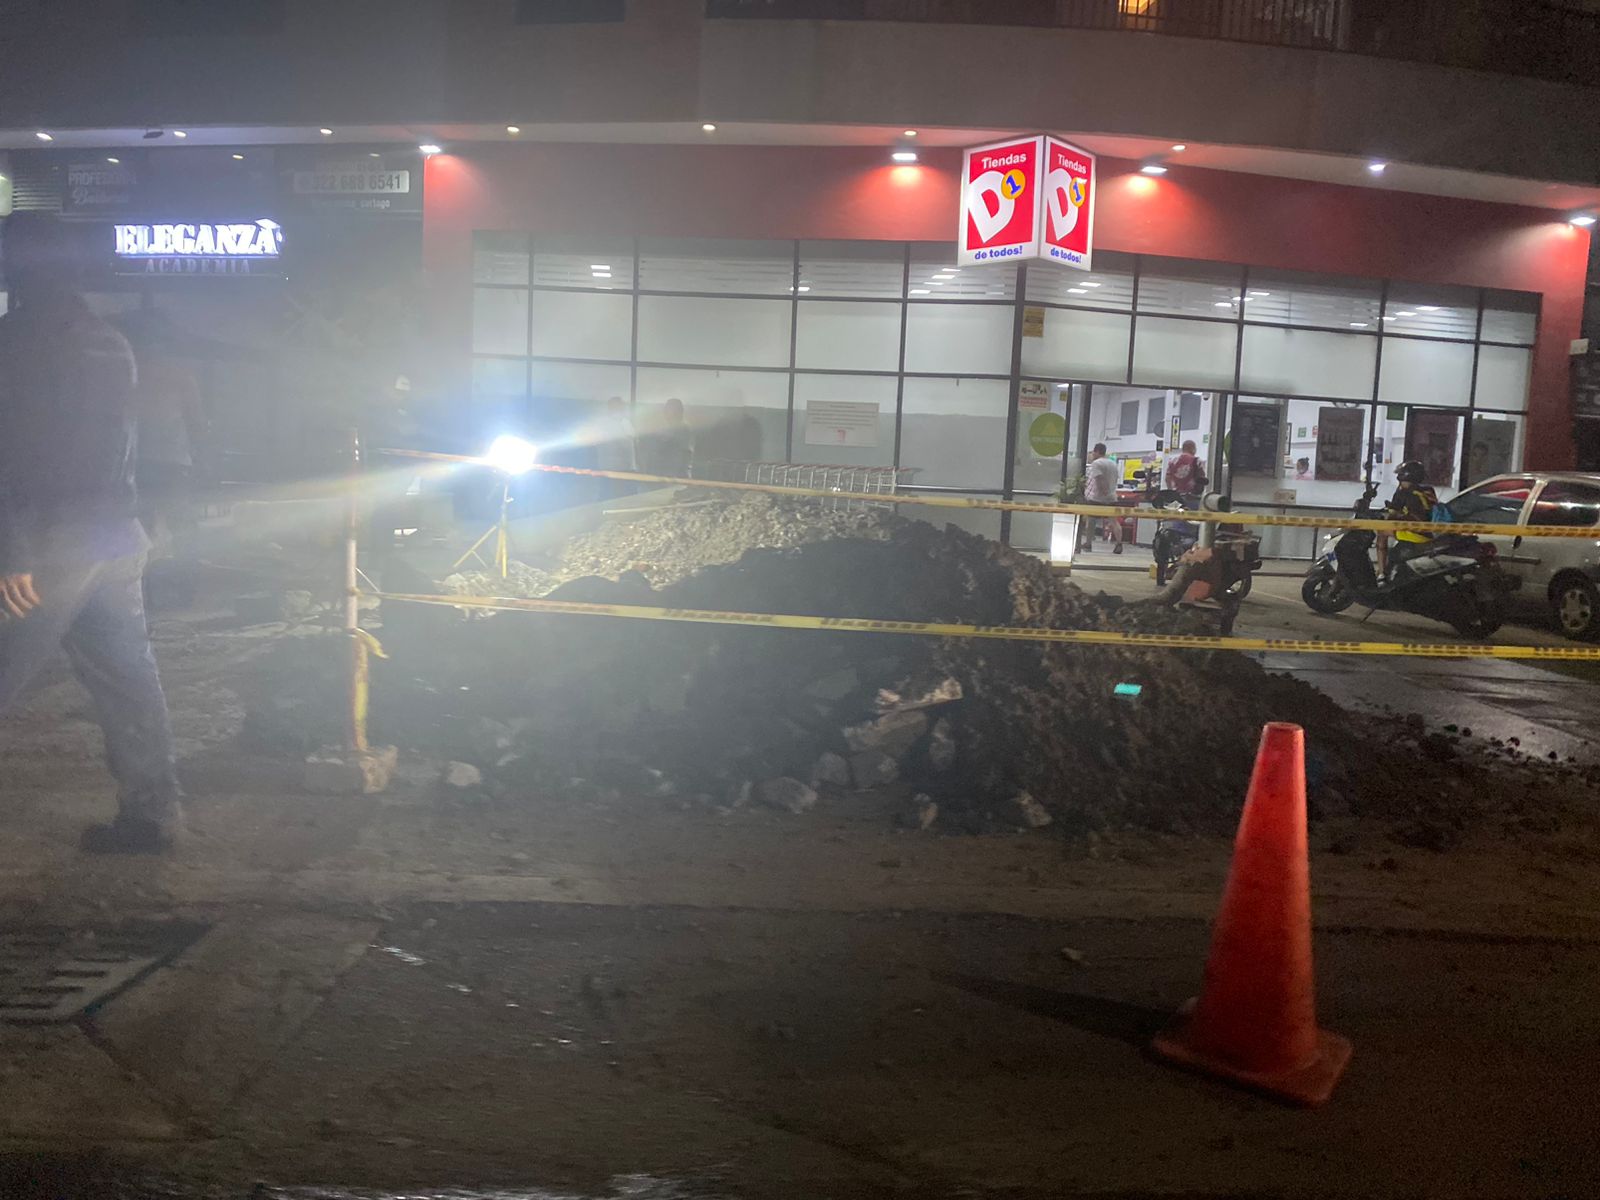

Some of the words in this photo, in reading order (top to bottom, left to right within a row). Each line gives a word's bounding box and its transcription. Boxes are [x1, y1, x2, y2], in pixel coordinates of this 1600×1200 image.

[981, 153, 1027, 169] Tiendas
[1057, 153, 1087, 175] Tiendas
[369, 173, 401, 190] 6541
[114, 218, 283, 255] ELEGANZA
[974, 251, 987, 260] de
[989, 246, 1023, 258] todos!
[1050, 247, 1060, 257] de
[1060, 250, 1082, 263] todos!
[145, 258, 250, 273] ACADEMIA
